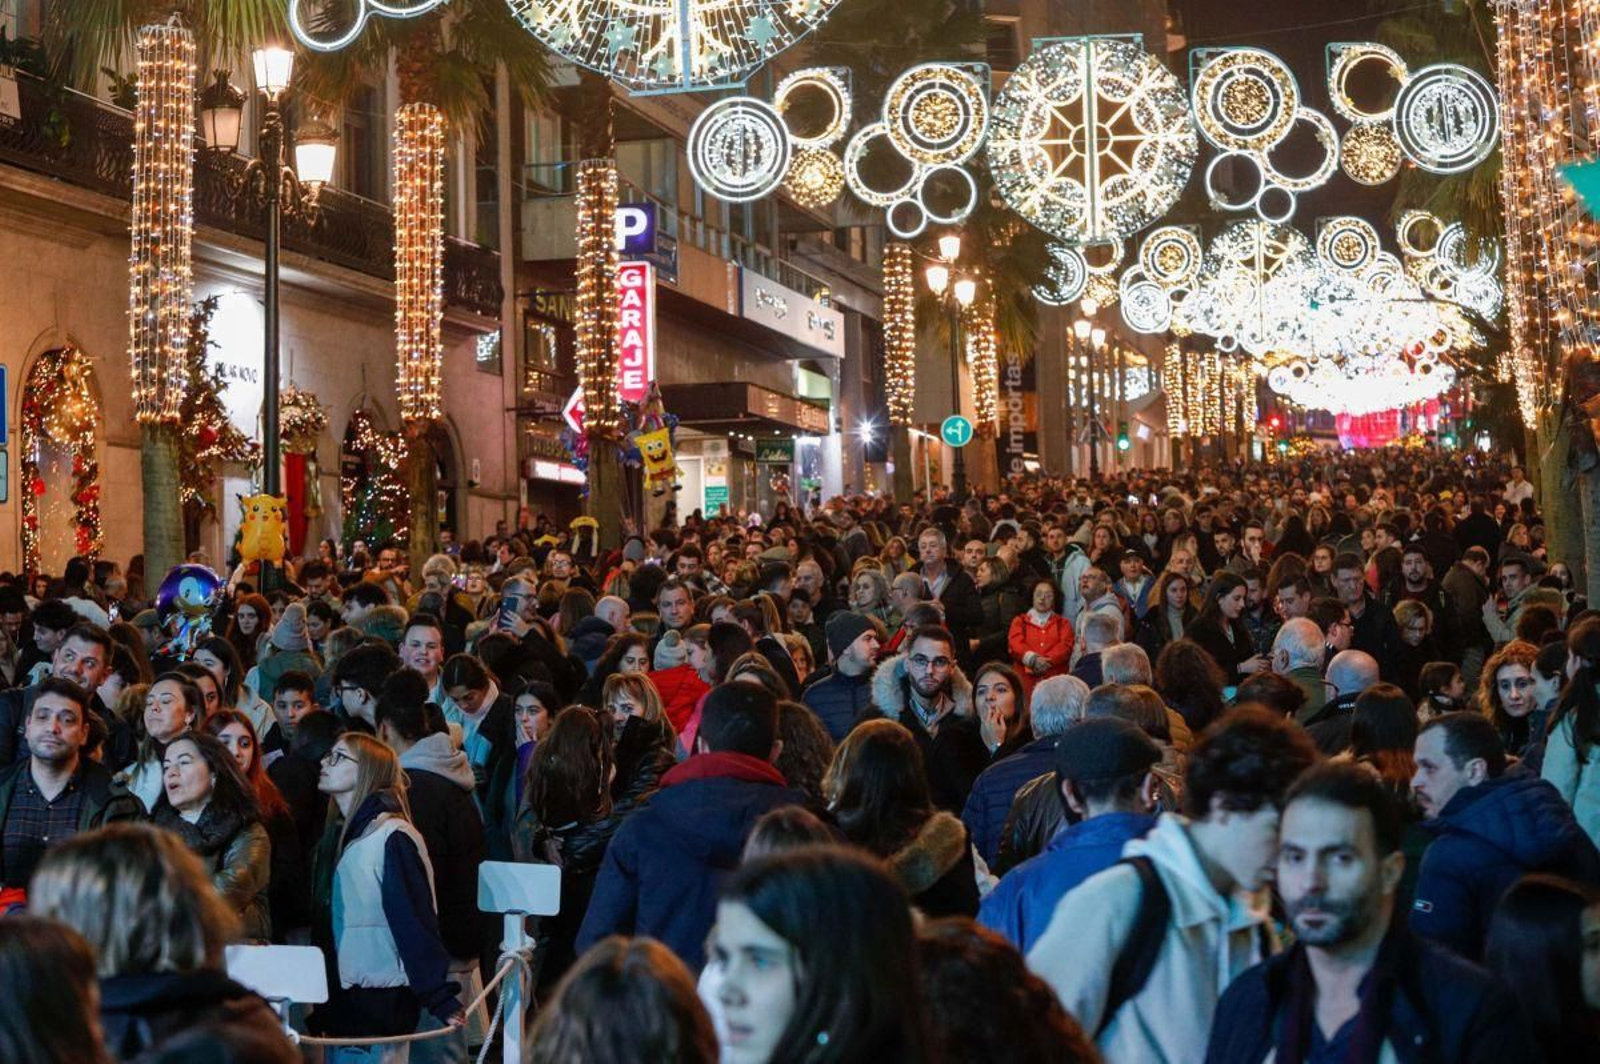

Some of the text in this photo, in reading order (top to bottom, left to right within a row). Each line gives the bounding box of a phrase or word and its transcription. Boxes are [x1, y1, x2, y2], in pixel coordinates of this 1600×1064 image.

[615, 208, 647, 250] P
[620, 269, 643, 390] GARAJE
[1005, 353, 1027, 453] importas
